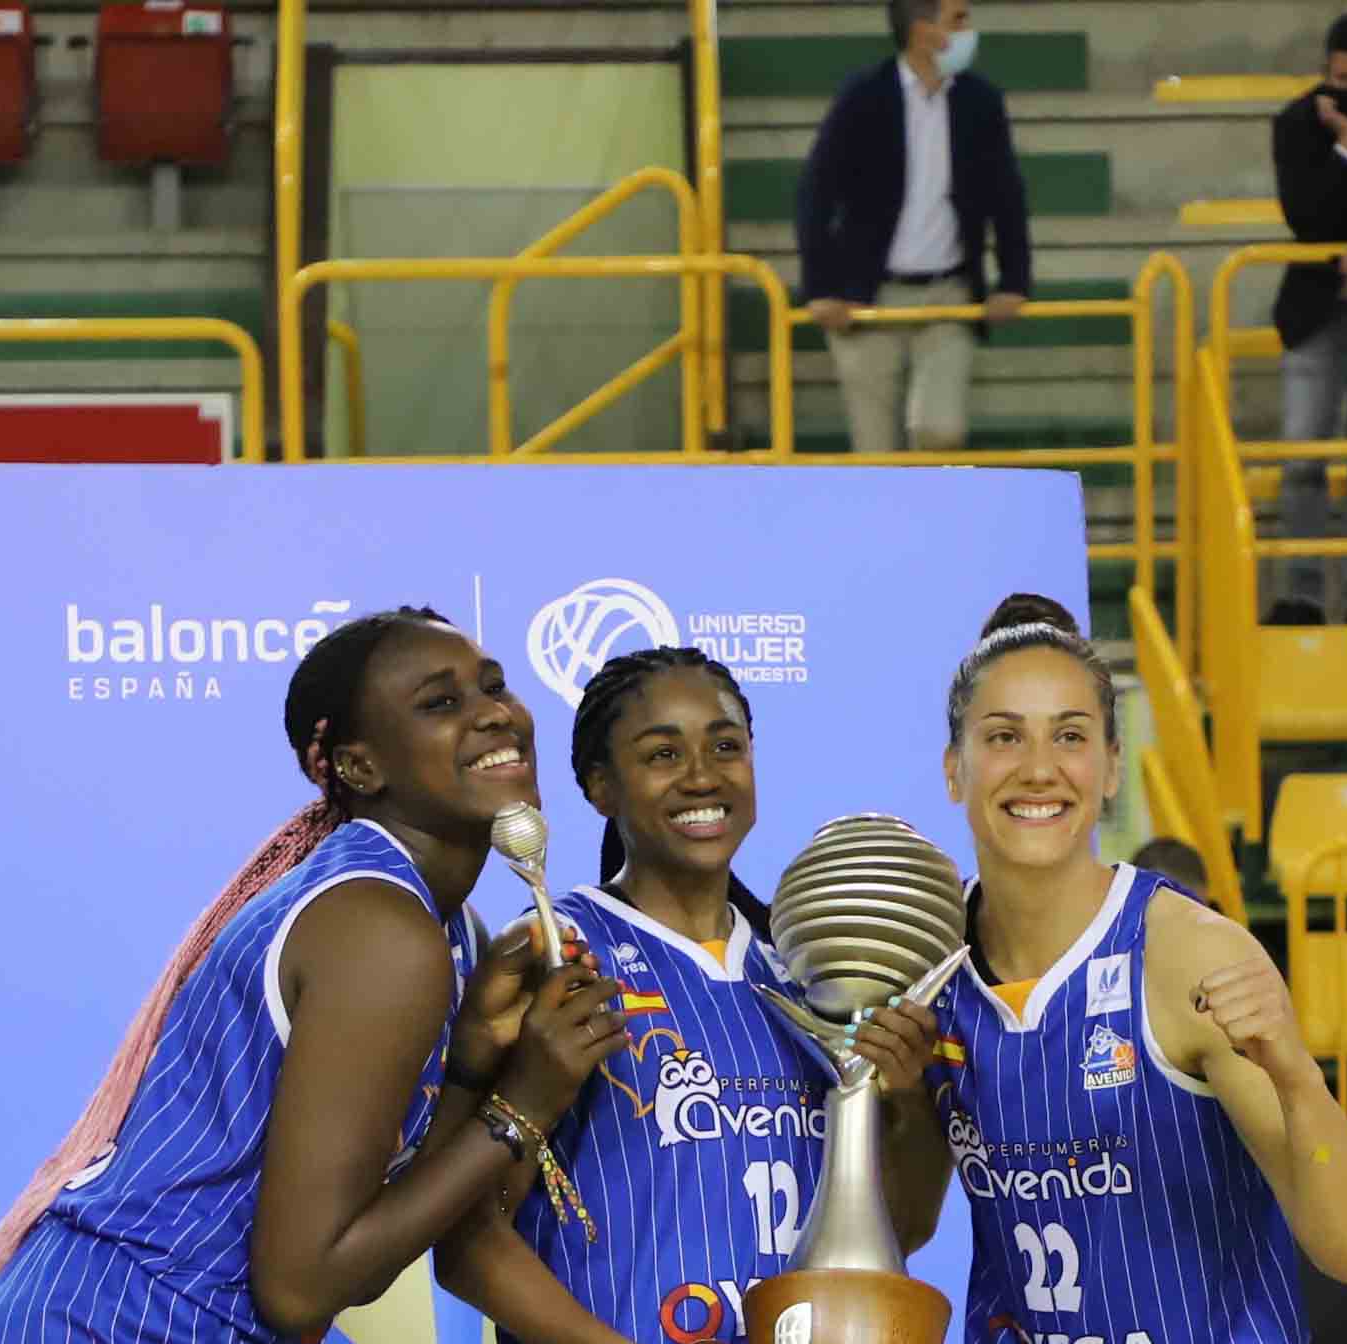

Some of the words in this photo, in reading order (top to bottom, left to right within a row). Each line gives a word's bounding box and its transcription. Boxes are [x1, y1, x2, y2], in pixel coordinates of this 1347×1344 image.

[689, 614, 806, 634] UNIVERSO
[692, 636, 806, 663] MUJER
[68, 670, 222, 700] ESPAÑA
[742, 1160, 804, 1256] 12
[1013, 1221, 1084, 1314] 22
